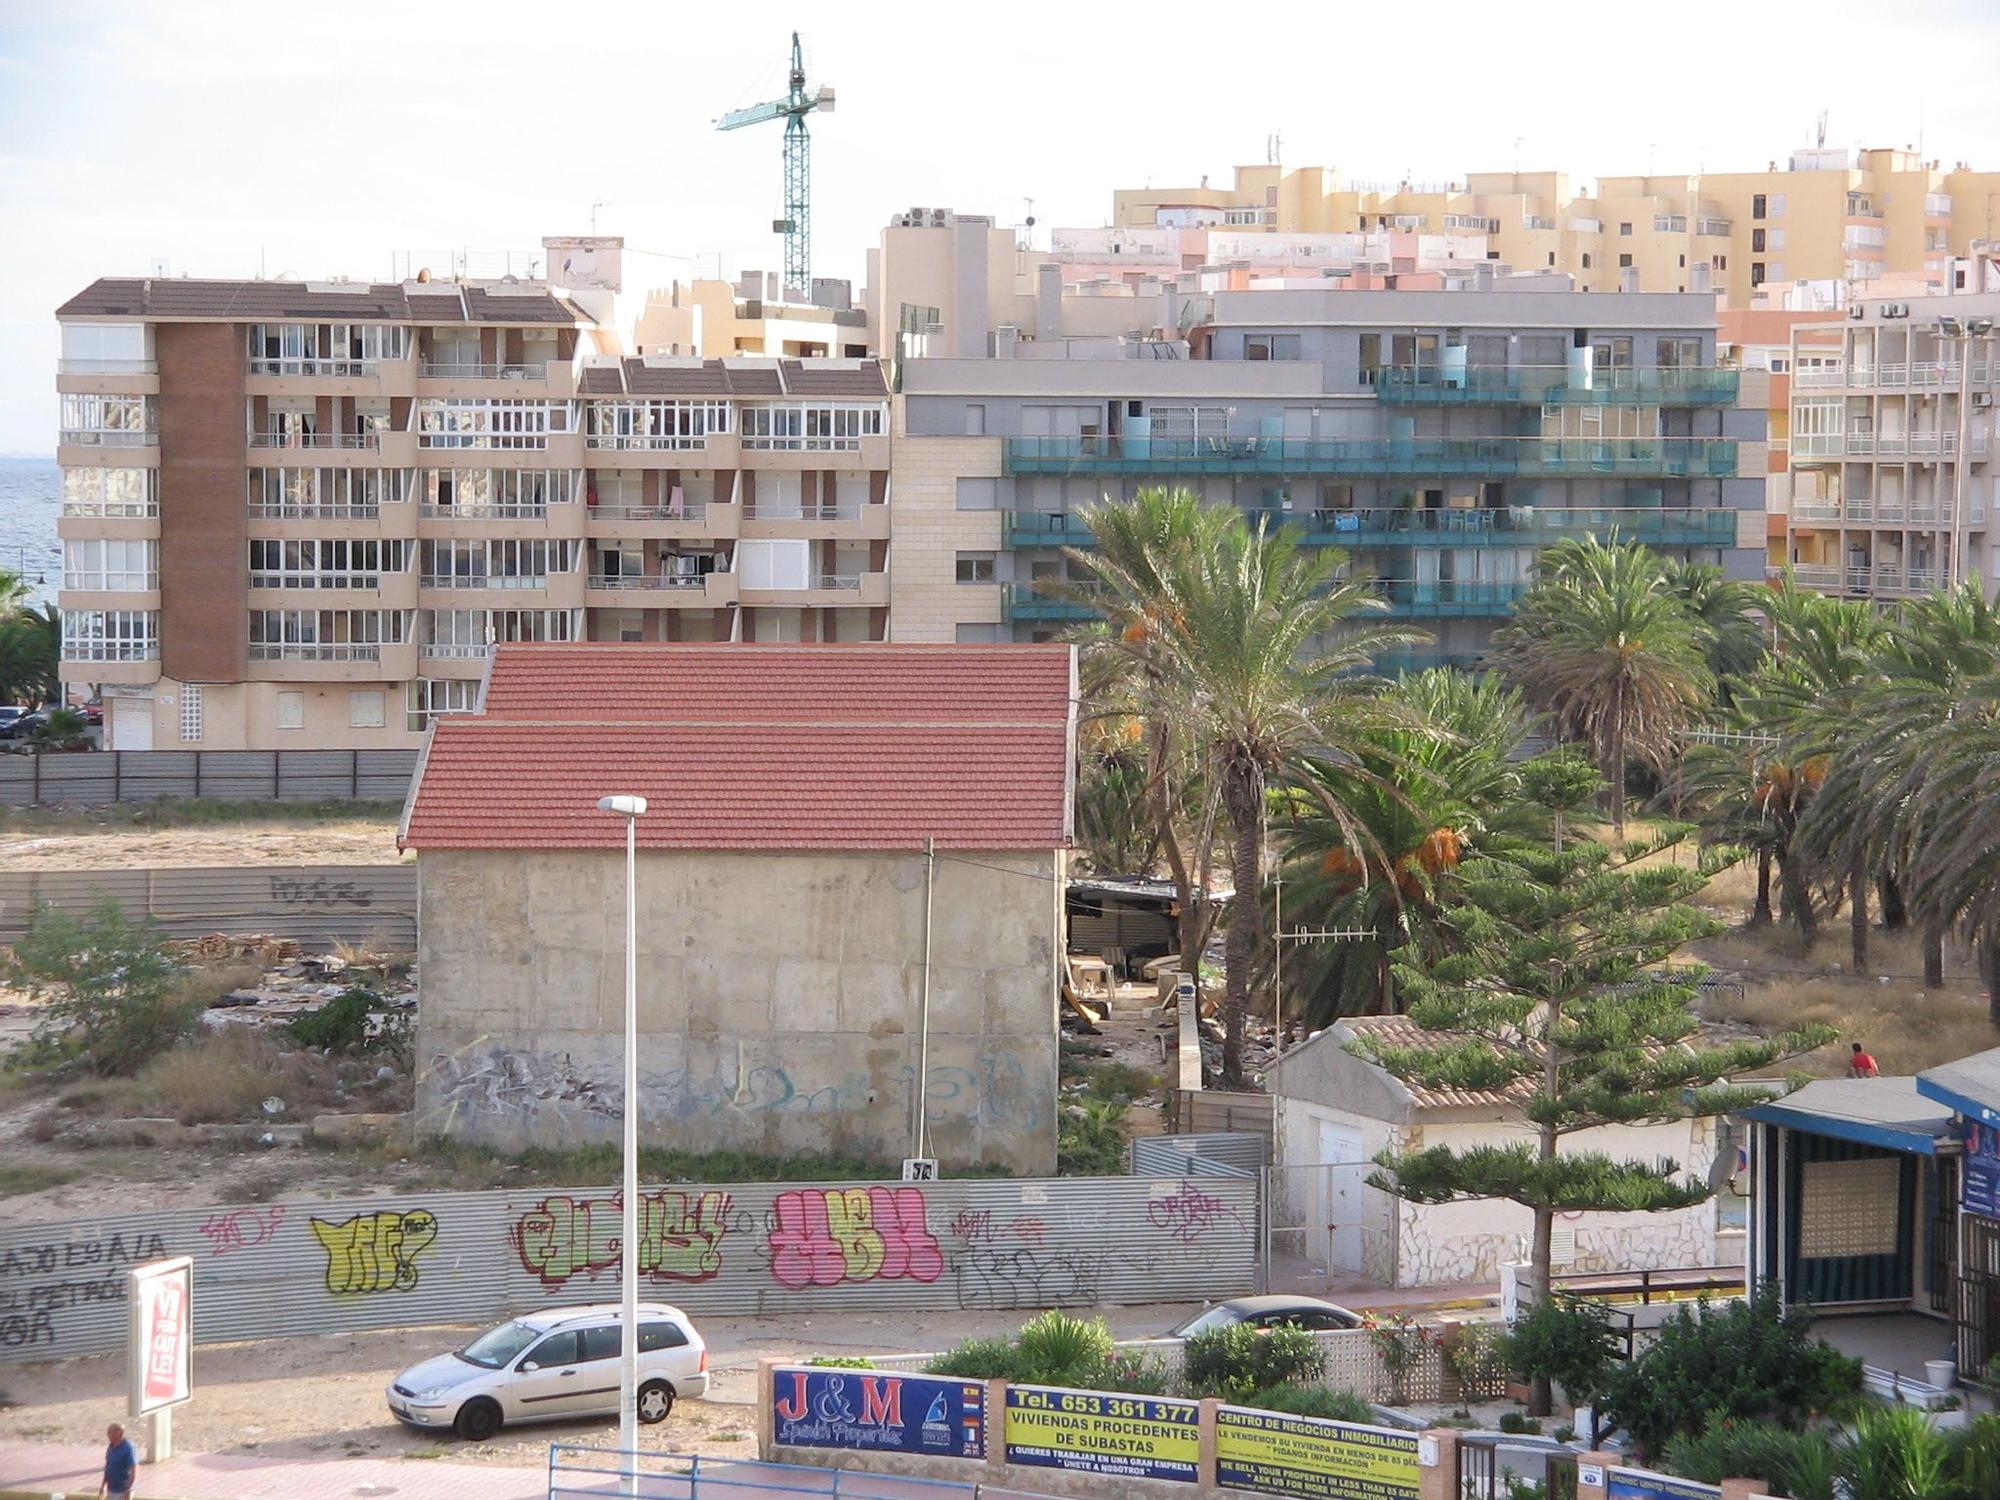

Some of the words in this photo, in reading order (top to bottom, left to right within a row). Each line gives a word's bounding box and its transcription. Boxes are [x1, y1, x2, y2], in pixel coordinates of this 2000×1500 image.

[776, 1373, 808, 1421] J
[813, 1375, 855, 1423] &
[858, 1376, 904, 1427] M
[1014, 1391, 1054, 1409] Tel.
[1061, 1395, 1100, 1413] 653
[1108, 1400, 1146, 1418] 361
[1154, 1404, 1195, 1422] 377
[1011, 1412, 1089, 1430] VIVIENDAS
[1093, 1420, 1199, 1442] PROCEDENTES
[1218, 1411, 1263, 1427] CENTRO
[1266, 1419, 1280, 1430] DE
[1282, 1421, 1338, 1439] NEGOCIOS
[1340, 1429, 1418, 1451] INMOBILIARIO
[1056, 1432, 1075, 1445] DE
[1080, 1435, 1154, 1453] SUBASTAS
[1218, 1430, 1229, 1439] LE
[1231, 1431, 1277, 1444] VENDEMOS
[1279, 1438, 1290, 1447] SU
[1292, 1440, 1330, 1453] VIVIENDA
[1333, 1447, 1345, 1456] EN
[1347, 1449, 1376, 1460] MENOS
[1378, 1454, 1389, 1463] DE
[1015, 1446, 1051, 1457] QUIERES
[1053, 1450, 1096, 1461] TRABAJAR
[1098, 1455, 1109, 1464] EN
[1110, 1457, 1128, 1465] UNA
[1130, 1458, 1152, 1468] GRAN
[1154, 1461, 1194, 1472] EMPRESA
[1101, 1464, 1145, 1475] NOSOTROS
[1221, 1461, 1233, 1470] WE
[1235, 1462, 1256, 1473] SELL
[1258, 1466, 1281, 1477] YOUR
[1283, 1469, 1327, 1484] PROPERTY
[1340, 1478, 1361, 1490] LESS
[1362, 1483, 1385, 1494] THAN
[1253, 1474, 1271, 1485] ASK
[1272, 1478, 1285, 1487] US
[1287, 1480, 1304, 1490] FOR
[1305, 1483, 1329, 1494] MORE
